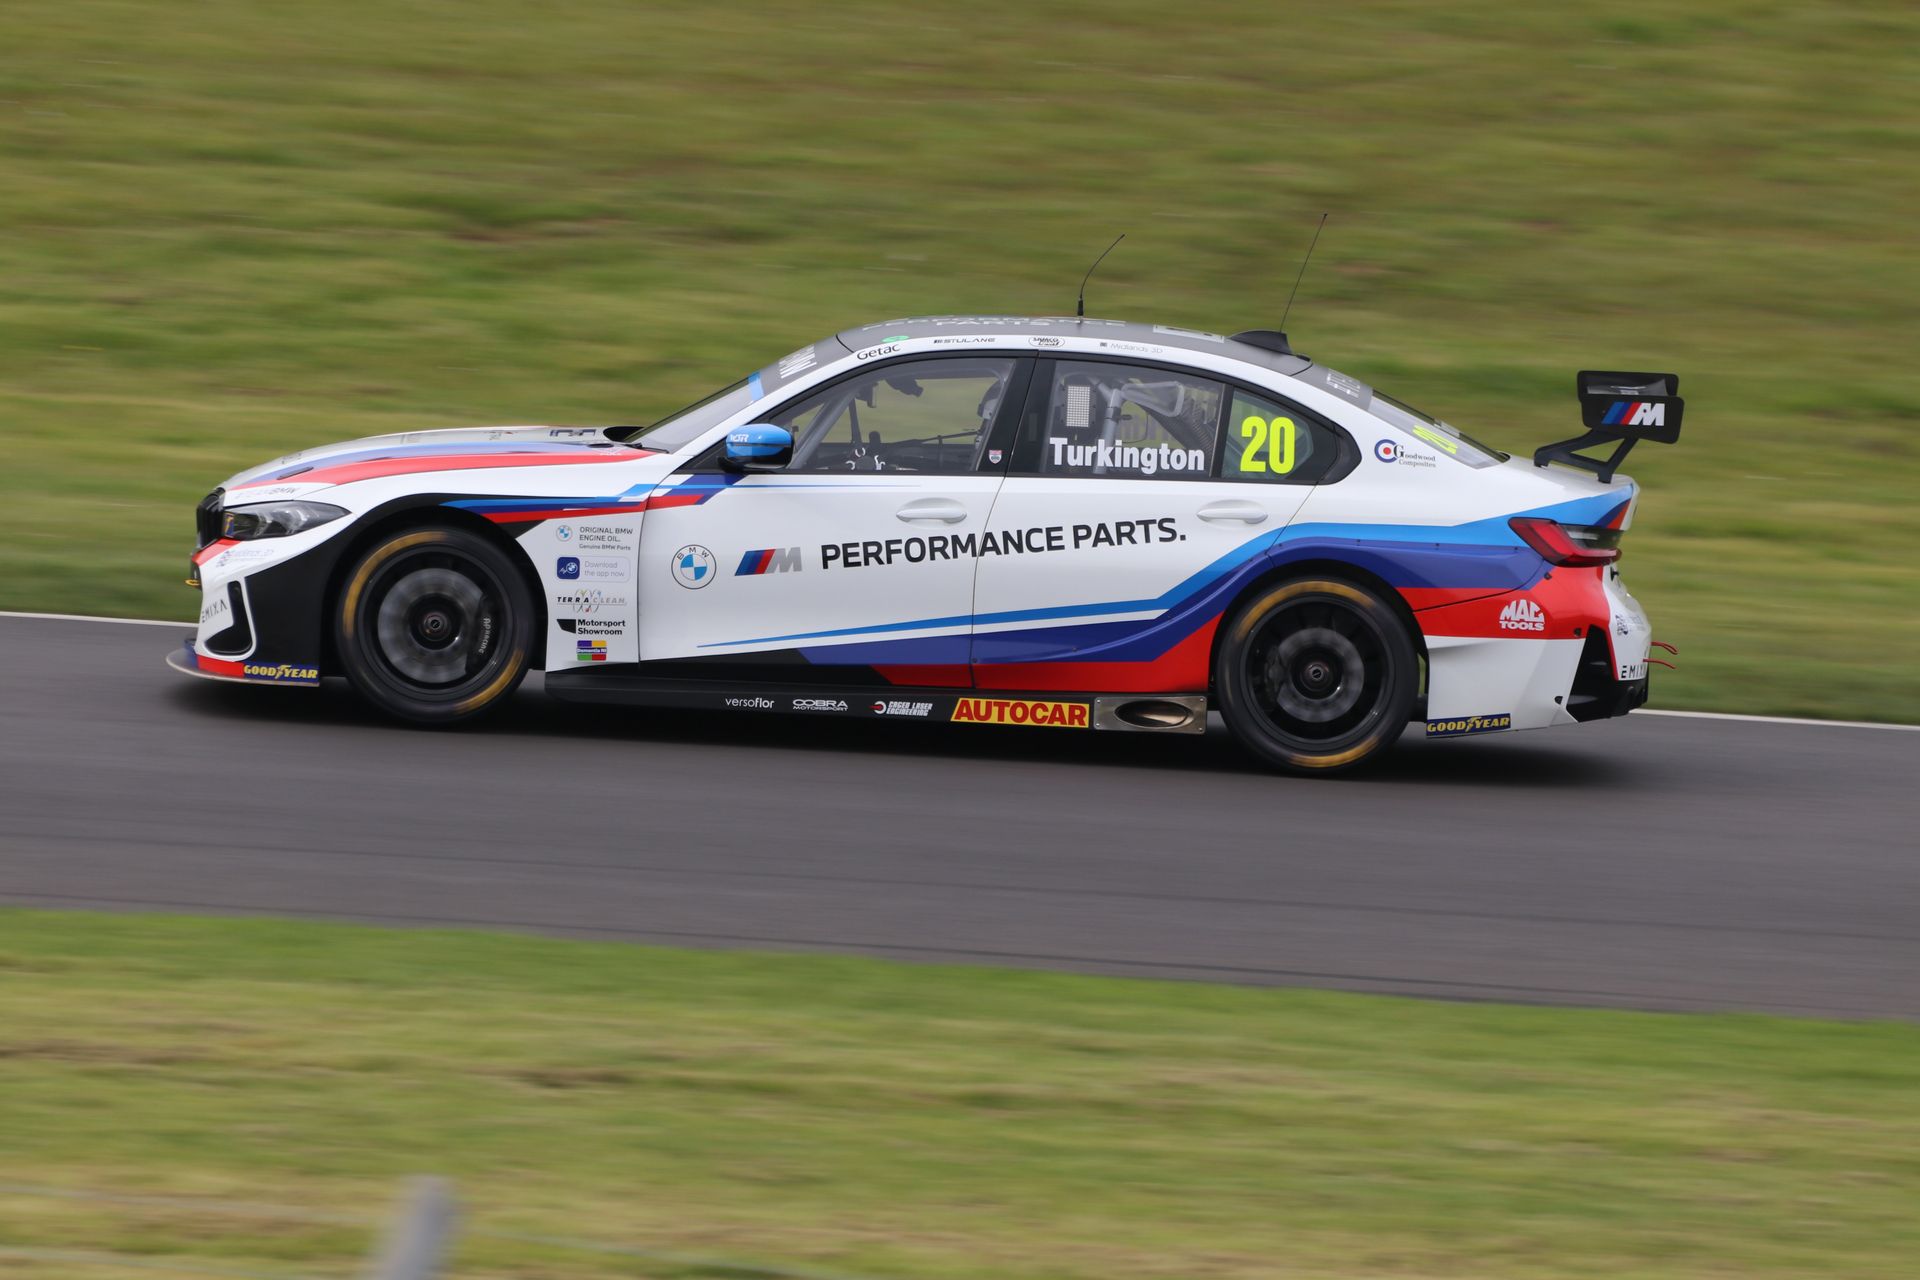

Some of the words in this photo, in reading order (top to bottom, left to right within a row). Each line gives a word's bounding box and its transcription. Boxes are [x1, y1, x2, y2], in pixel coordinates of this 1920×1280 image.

[857, 343, 901, 360] Getac
[1628, 402, 1666, 427] M
[1239, 416, 1296, 474] 20
[1049, 437, 1205, 474] Turkington
[1393, 444, 1436, 461] Goodwood
[1399, 459, 1436, 467] Composites
[579, 526, 613, 535] ORIGINAL
[615, 527, 634, 535] BMW
[579, 534, 606, 542] ENGINE
[820, 525, 1066, 570] PERFORMANCE
[1072, 517, 1187, 549] PARTS.
[584, 560, 618, 568] Download
[764, 546, 803, 574] M
[597, 571, 609, 580] app
[1499, 598, 1546, 623] MAC
[577, 619, 626, 628] Motorsport
[1499, 620, 1545, 632] TOOLS
[577, 627, 623, 636] Showroom
[725, 697, 775, 709] versoflor
[792, 698, 848, 708] COBRA
[953, 699, 1087, 727] AUTOCAR
